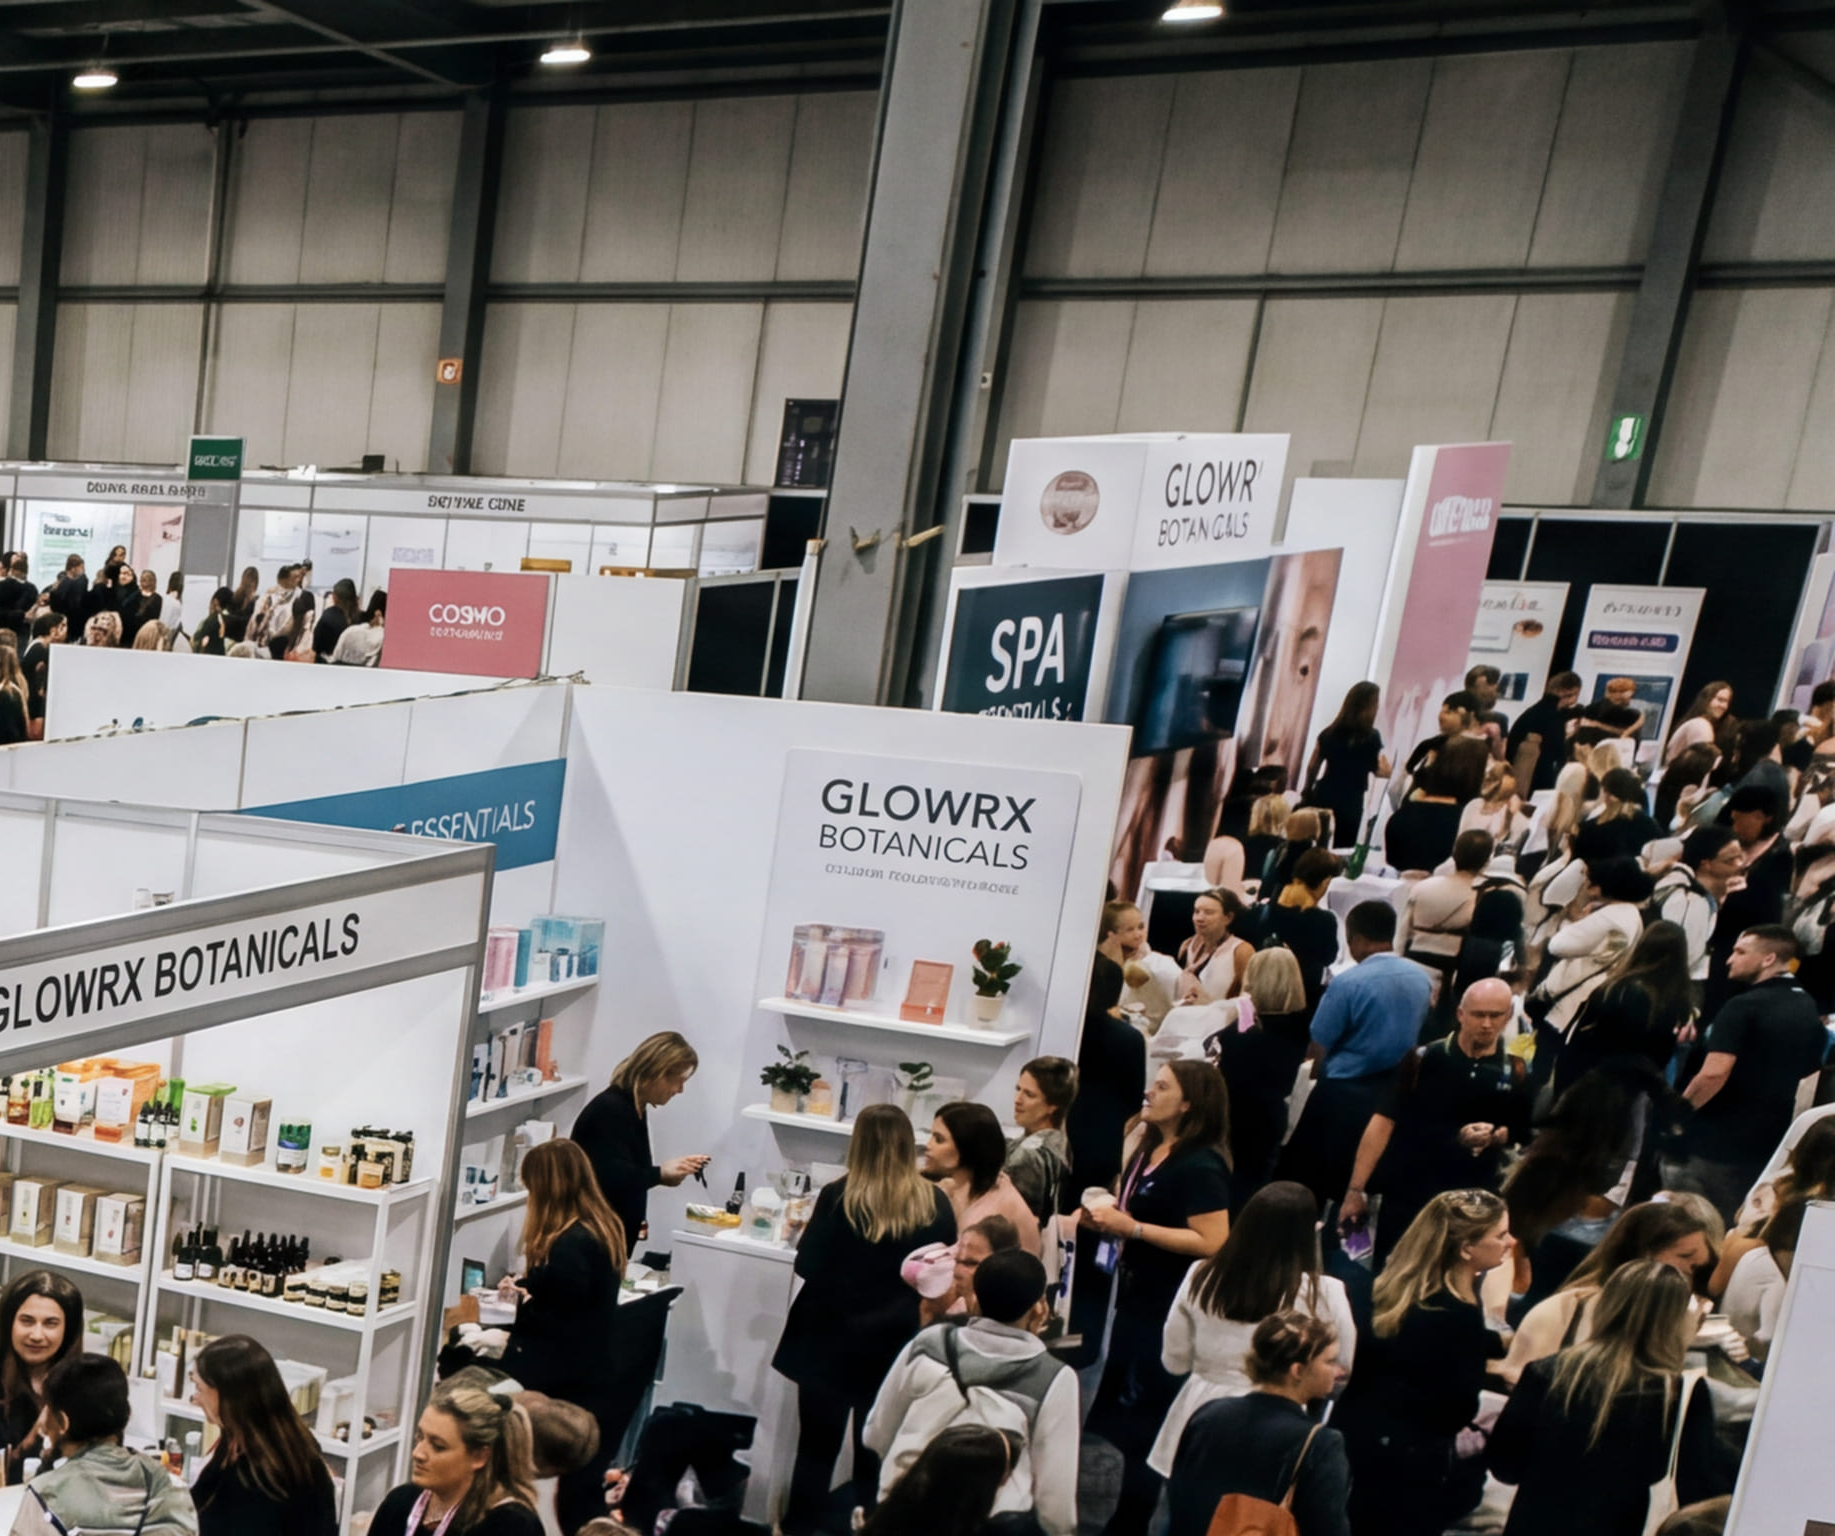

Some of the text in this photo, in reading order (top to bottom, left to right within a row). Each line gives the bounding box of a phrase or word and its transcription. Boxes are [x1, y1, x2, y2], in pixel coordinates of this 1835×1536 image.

[984, 612, 1066, 693] SPA
[411, 799, 536, 841] ESSENTIALS
[820, 777, 1037, 835] GLOWRX
[818, 822, 1030, 871] BOTANICALS
[152, 910, 362, 997] BOTANICALS
